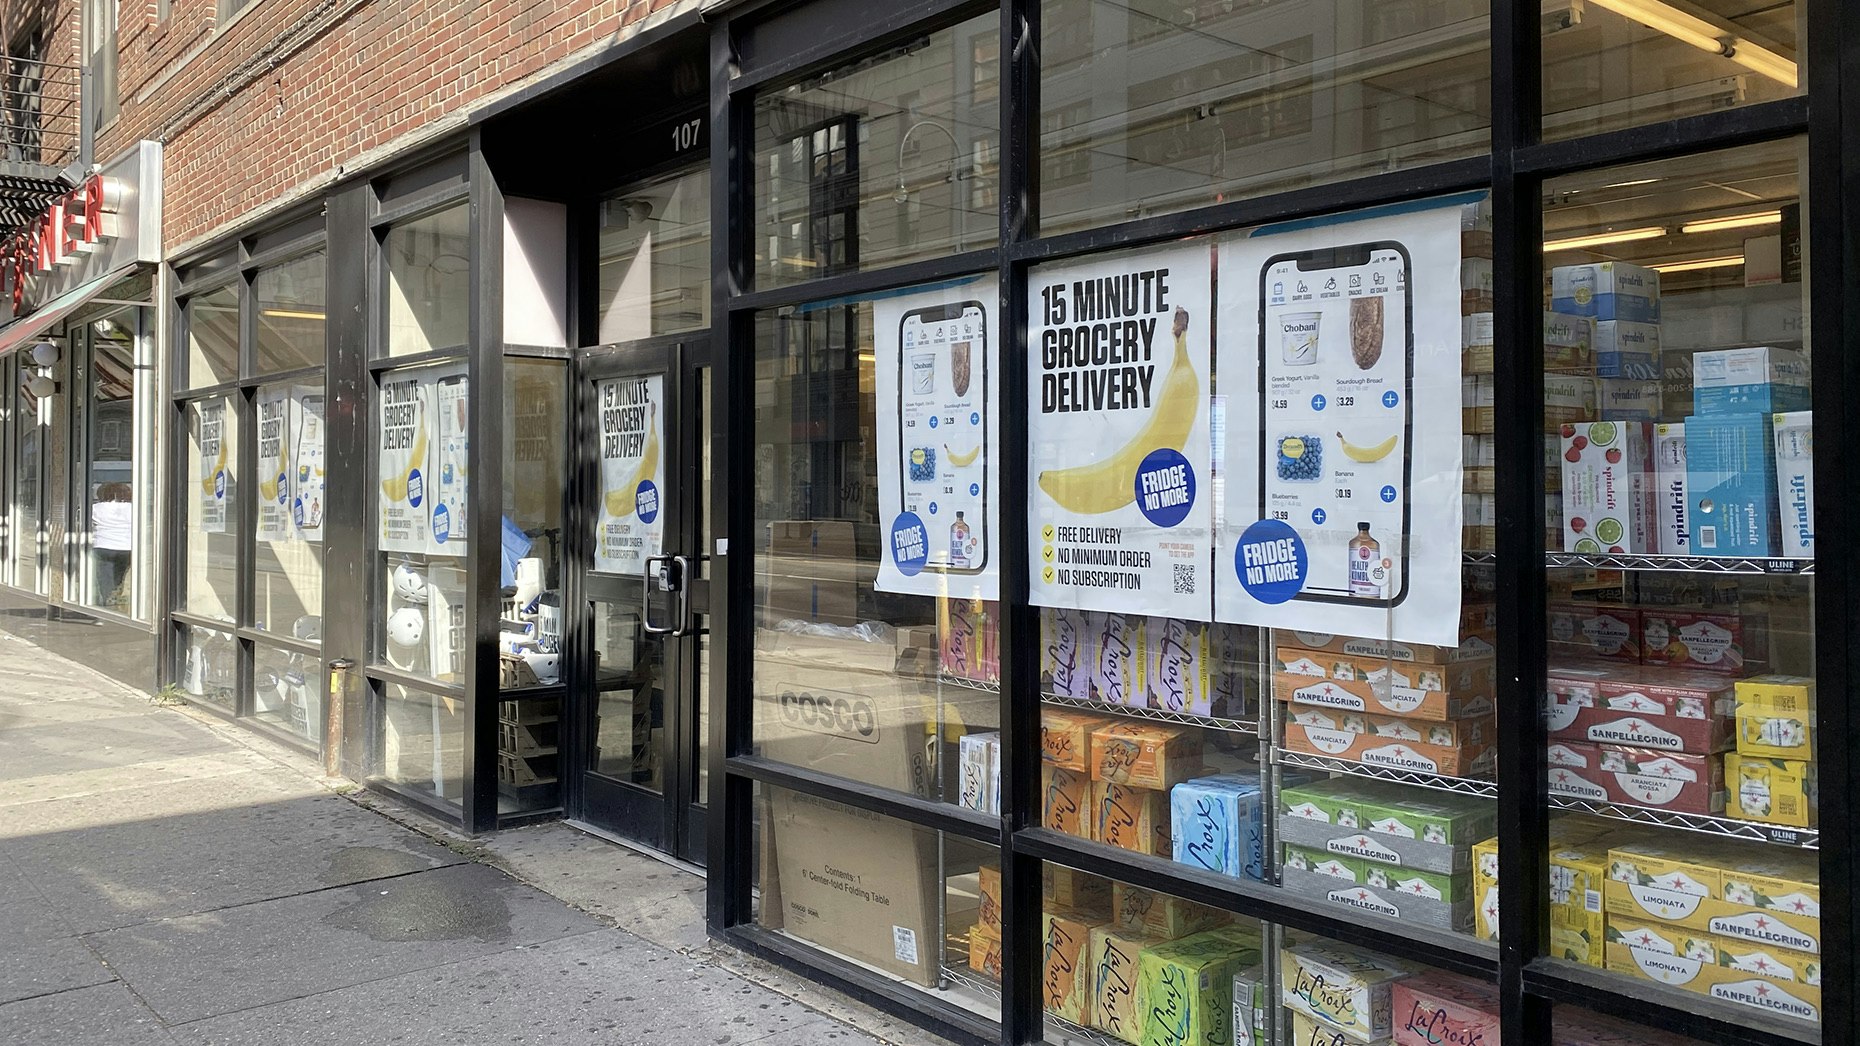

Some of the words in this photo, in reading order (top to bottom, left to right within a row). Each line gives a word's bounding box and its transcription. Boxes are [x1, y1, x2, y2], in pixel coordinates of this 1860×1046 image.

[672, 118, 701, 152] 107
[1618, 275, 1643, 289] spindrift
[1041, 284, 1066, 326] 15
[1073, 268, 1169, 322] MINUTE
[1284, 322, 1317, 333] Chobani
[1041, 318, 1157, 370] GROCERY
[1622, 333, 1645, 346] spindrift
[384, 382, 392, 405] 15
[392, 379, 419, 404] MINUTE
[604, 384, 614, 408] 15
[614, 379, 649, 407] MINUTE
[1041, 365, 1155, 413] DELIVERY
[1611, 388, 1641, 405] spindrift
[1336, 396, 1354, 407] $3.29
[384, 403, 416, 428] GROCERY
[603, 406, 646, 433] GROCERY
[384, 427, 416, 450] DELIVERY
[604, 432, 645, 459] DELIVERY
[1141, 464, 1187, 494] FRIDGE
[1602, 466, 1616, 510] spindrift
[1144, 493, 1159, 511] NO
[1160, 486, 1189, 510] MORE
[1335, 488, 1352, 498] $0.19
[1271, 511, 1289, 520] $3.99
[1670, 480, 1690, 546] spindrift
[1790, 475, 1815, 548] spindrift
[1058, 526, 1078, 543] FREE
[1079, 527, 1122, 544] DELIVERY
[1744, 503, 1759, 545] spindrift
[894, 525, 922, 548] FRIDGE
[896, 546, 906, 562] NO
[906, 543, 925, 561] MORE
[1058, 548, 1070, 564] NO
[1071, 549, 1118, 566] MINIMUM
[1119, 551, 1151, 568] ORDER
[1242, 538, 1297, 567] FRIDGE
[1246, 566, 1264, 585] NO
[1265, 561, 1300, 583] MORE
[1769, 560, 1794, 569] ULINE
[1058, 569, 1070, 585] NO
[1072, 569, 1141, 590] SUBSCRIPTION
[1583, 629, 1628, 637] SANPELLEGRINO
[1681, 636, 1730, 645] SANPELLEGRINO
[1296, 692, 1361, 707] SANPELLEGRINO
[781, 689, 874, 736] COSCO
[1312, 735, 1347, 745] ARANCIATA
[1592, 728, 1678, 747] SANPELLEGRINO
[1365, 753, 1433, 771] SANPELLEGRINO
[1548, 782, 1602, 797] ELLEGRINO
[1630, 778, 1668, 788] ARANCIATA
[1638, 784, 1660, 792] ROSSA
[1771, 830, 1797, 841] ULINE
[1330, 842, 1397, 862] SANPELLEGRINO
[824, 864, 857, 883] Contents:
[857, 875, 862, 884] 1
[808, 871, 844, 891] Center-fold
[844, 883, 870, 902] Folding
[871, 891, 890, 906] Table
[1330, 894, 1396, 916] SANPELLEGRINO
[1642, 894, 1686, 909] LIMONATA
[1714, 921, 1811, 948] SANPELLEGRINO
[1045, 917, 1073, 1010] LaCroix
[1644, 959, 1688, 974] LIMONATA
[1099, 937, 1132, 1033] LaCroix
[1292, 966, 1354, 1016] LaCroix
[1715, 987, 1812, 1016] SANPELLEGRINO
[1404, 1000, 1484, 1046] LaCroix
